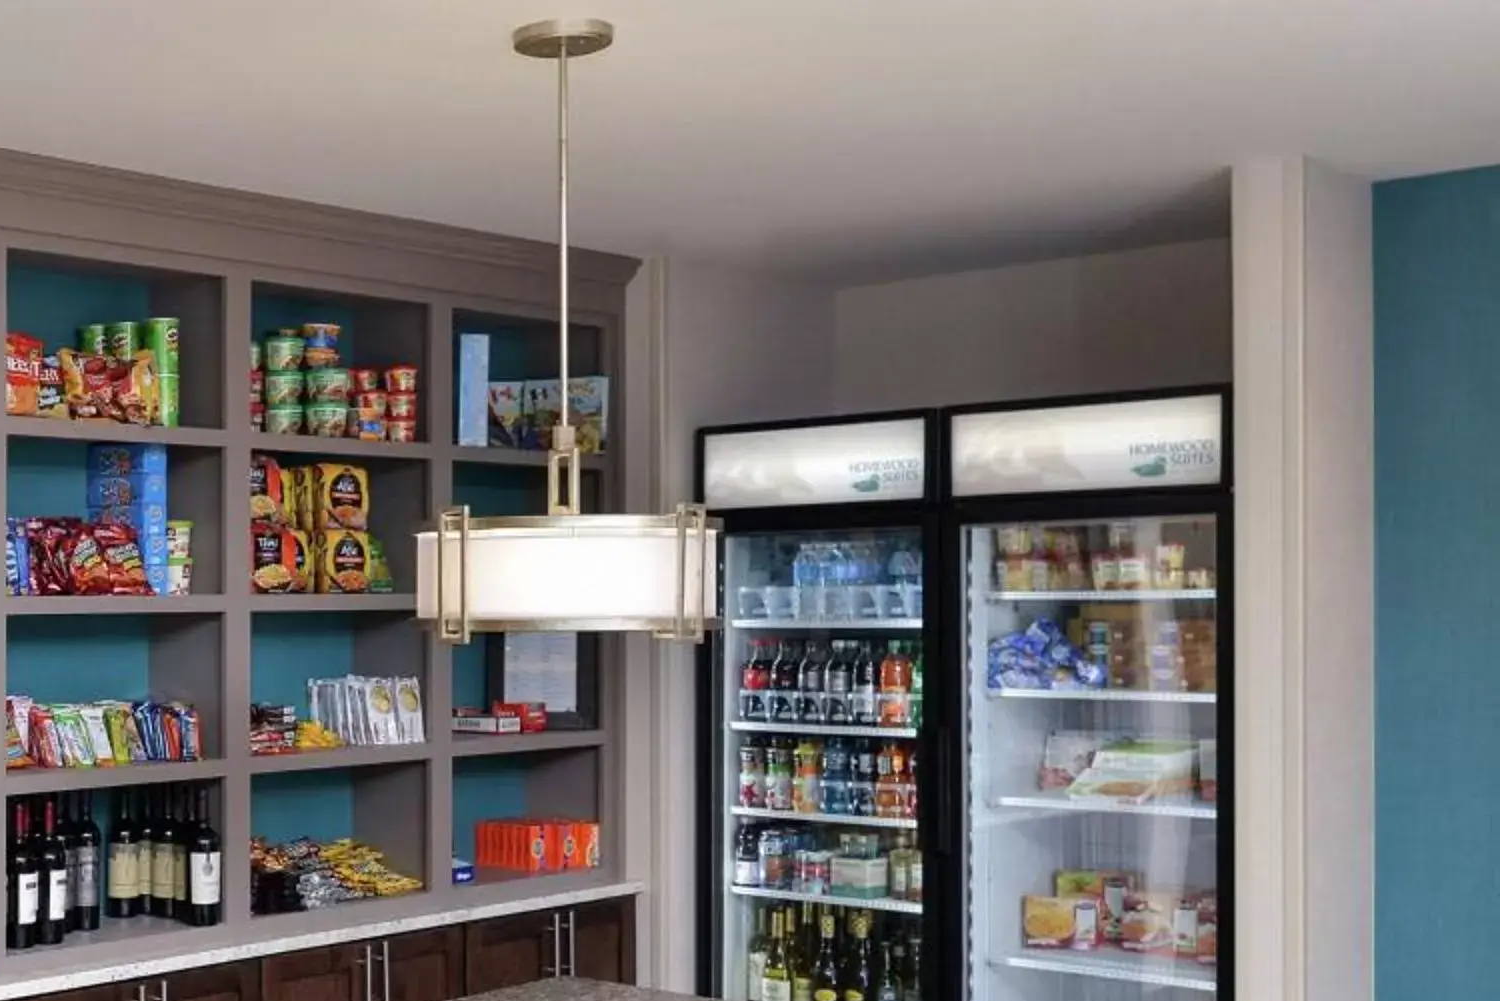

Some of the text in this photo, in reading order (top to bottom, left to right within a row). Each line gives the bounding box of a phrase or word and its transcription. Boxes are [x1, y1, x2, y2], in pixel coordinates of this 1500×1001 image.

[1129, 439, 1214, 457] HOMEWOOD
[849, 457, 919, 473] HOMEWOOD
[1170, 452, 1214, 466] SUITES
[883, 470, 919, 483] SUITES
